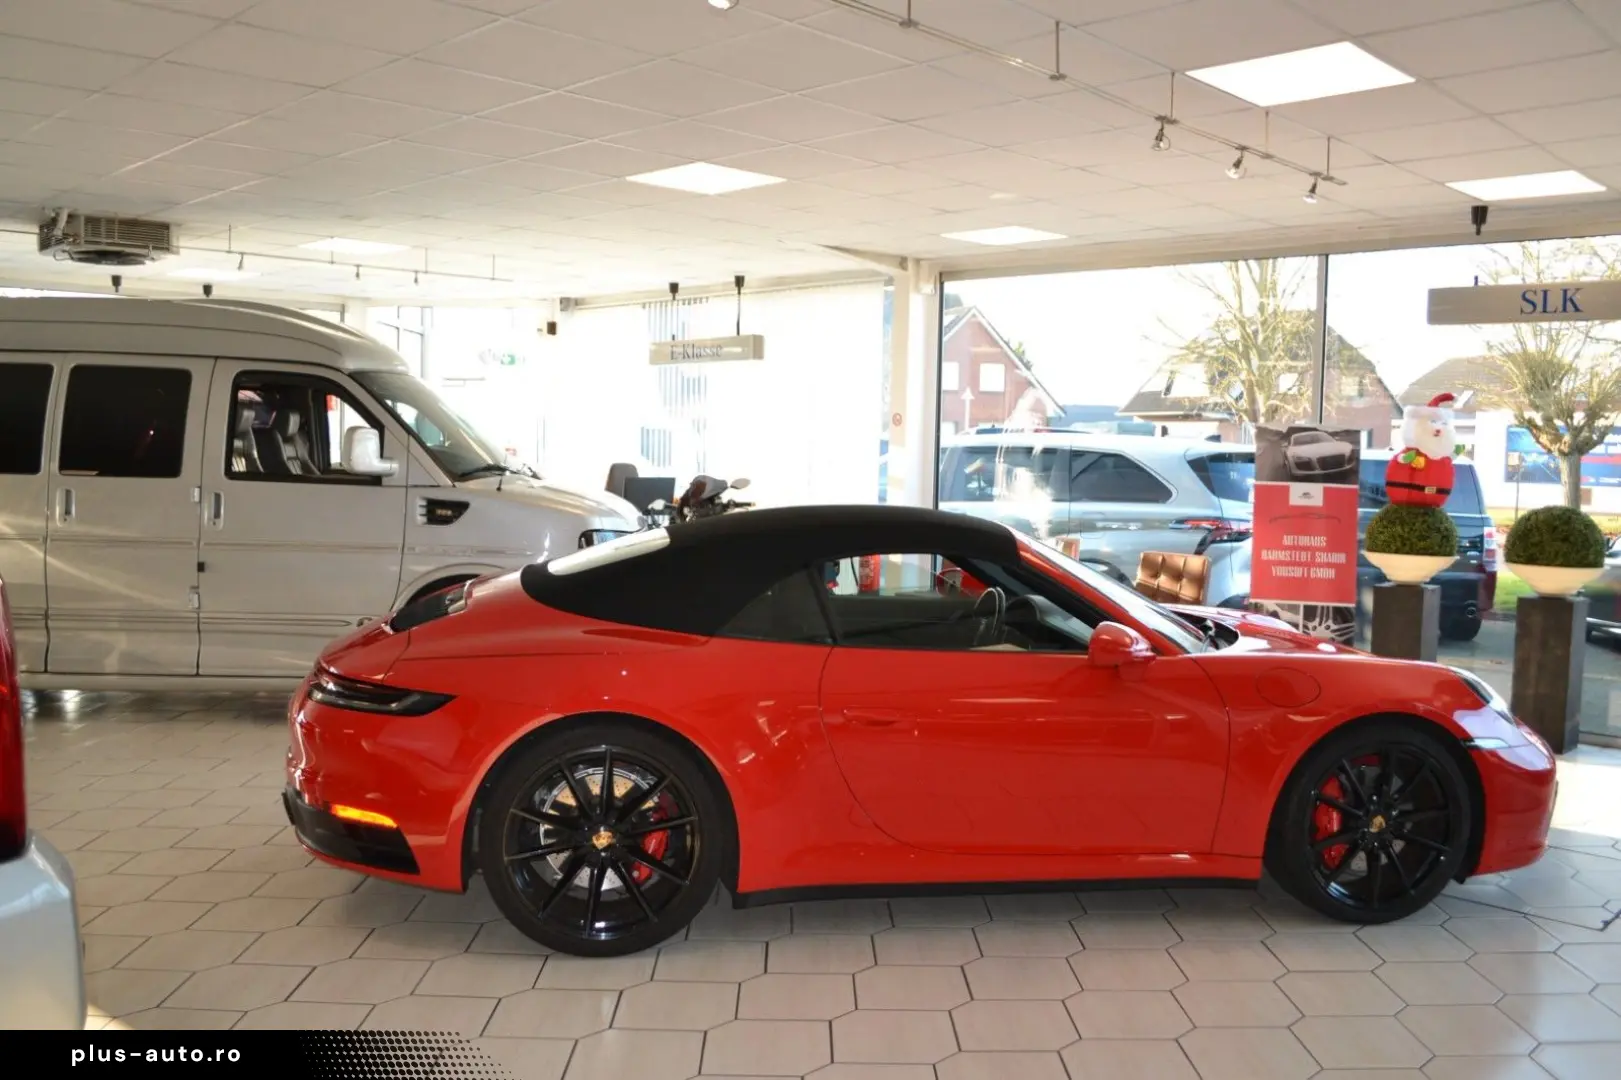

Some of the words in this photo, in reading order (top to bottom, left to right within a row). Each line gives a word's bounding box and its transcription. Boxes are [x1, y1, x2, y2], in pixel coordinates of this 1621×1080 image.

[1520, 287, 1584, 315] SLK
[670, 343, 723, 360] E-Klasse
[1282, 534, 1327, 547] AUTOHAUS
